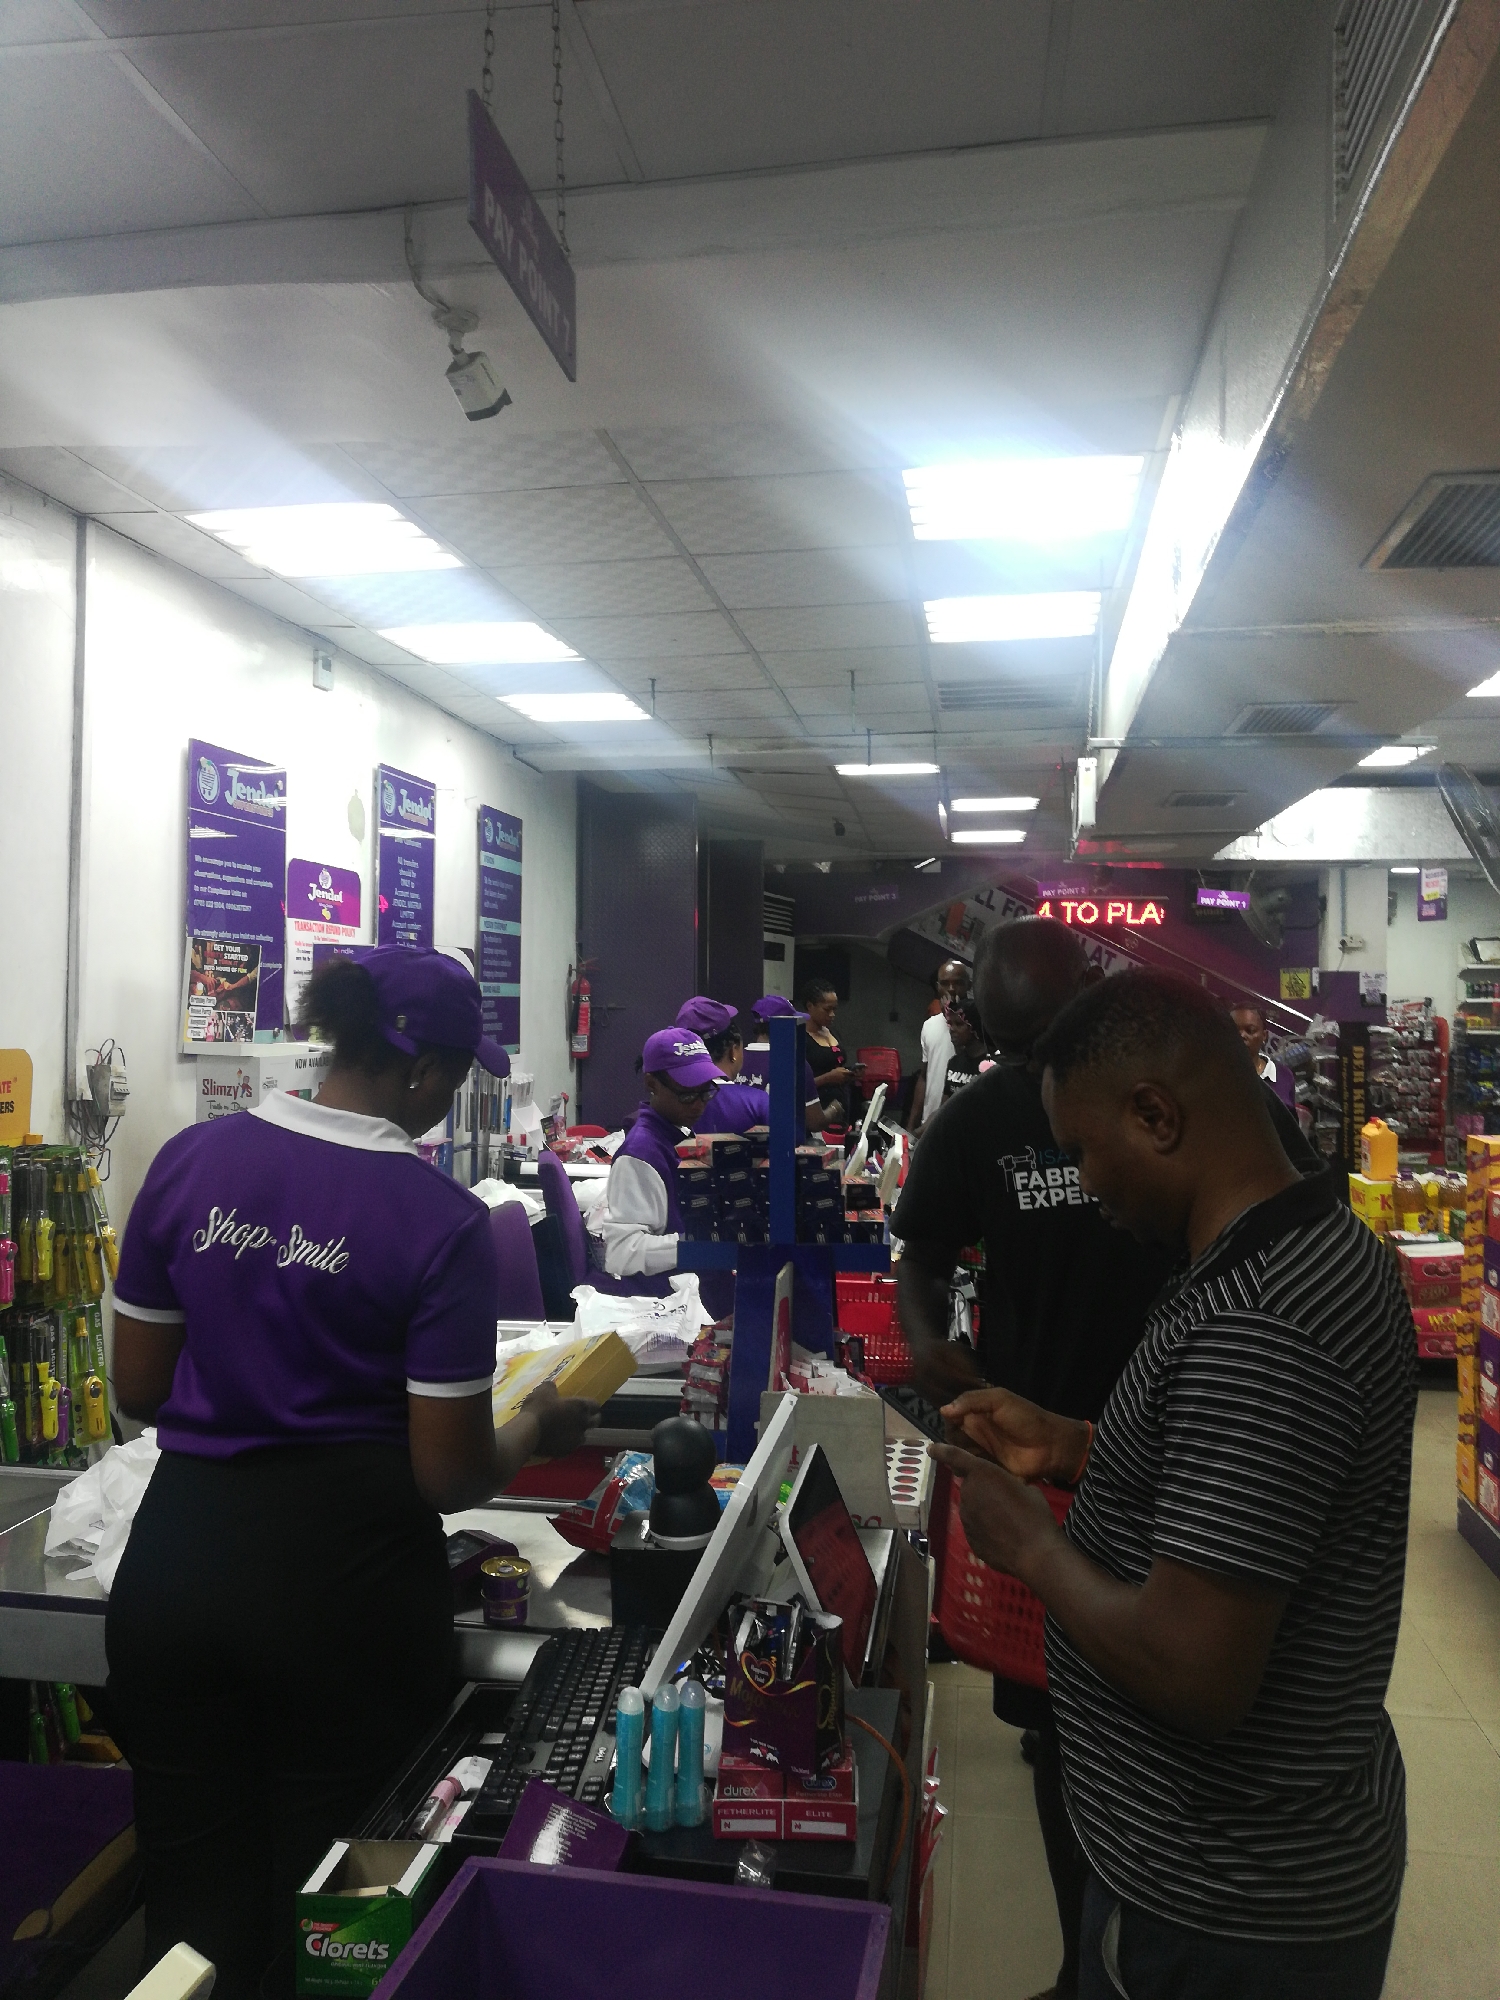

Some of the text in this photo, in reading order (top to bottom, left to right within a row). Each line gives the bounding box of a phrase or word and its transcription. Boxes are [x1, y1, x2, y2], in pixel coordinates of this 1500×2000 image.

[484, 181, 514, 262] PAY
[519, 238, 561, 336] POINT
[1061, 901, 1099, 924] TO
[1107, 901, 1165, 925] PLA
[295, 1058, 307, 1069] NOW
[96, 1334, 104, 1368] LIGHTER
[723, 1784, 758, 1797] durex
[717, 1808, 833, 1818] FETHERLITE ELITE
[305, 1933, 389, 1961] Clorets
